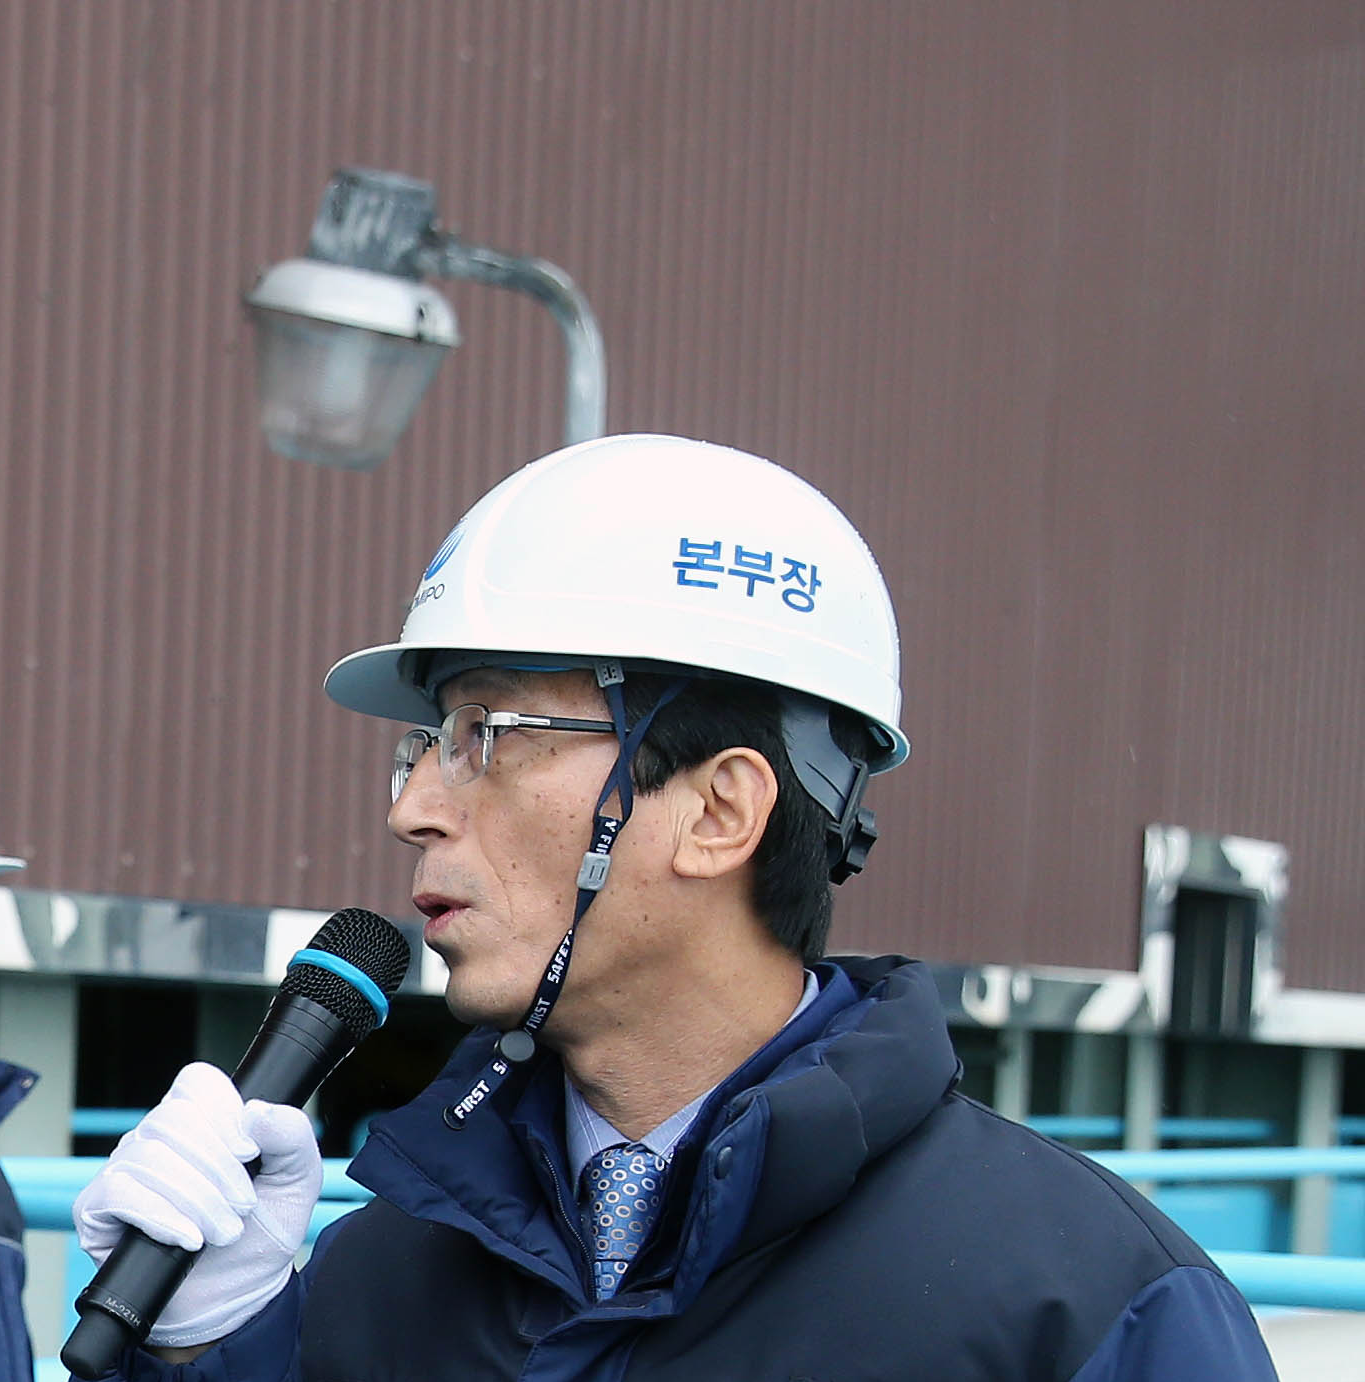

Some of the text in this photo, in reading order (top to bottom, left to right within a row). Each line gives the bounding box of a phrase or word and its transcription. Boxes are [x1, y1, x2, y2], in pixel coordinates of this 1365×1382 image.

[672, 537, 821, 613] 본부장
[526, 997, 552, 1030] FIRST
[454, 1079, 491, 1120] FIRST
